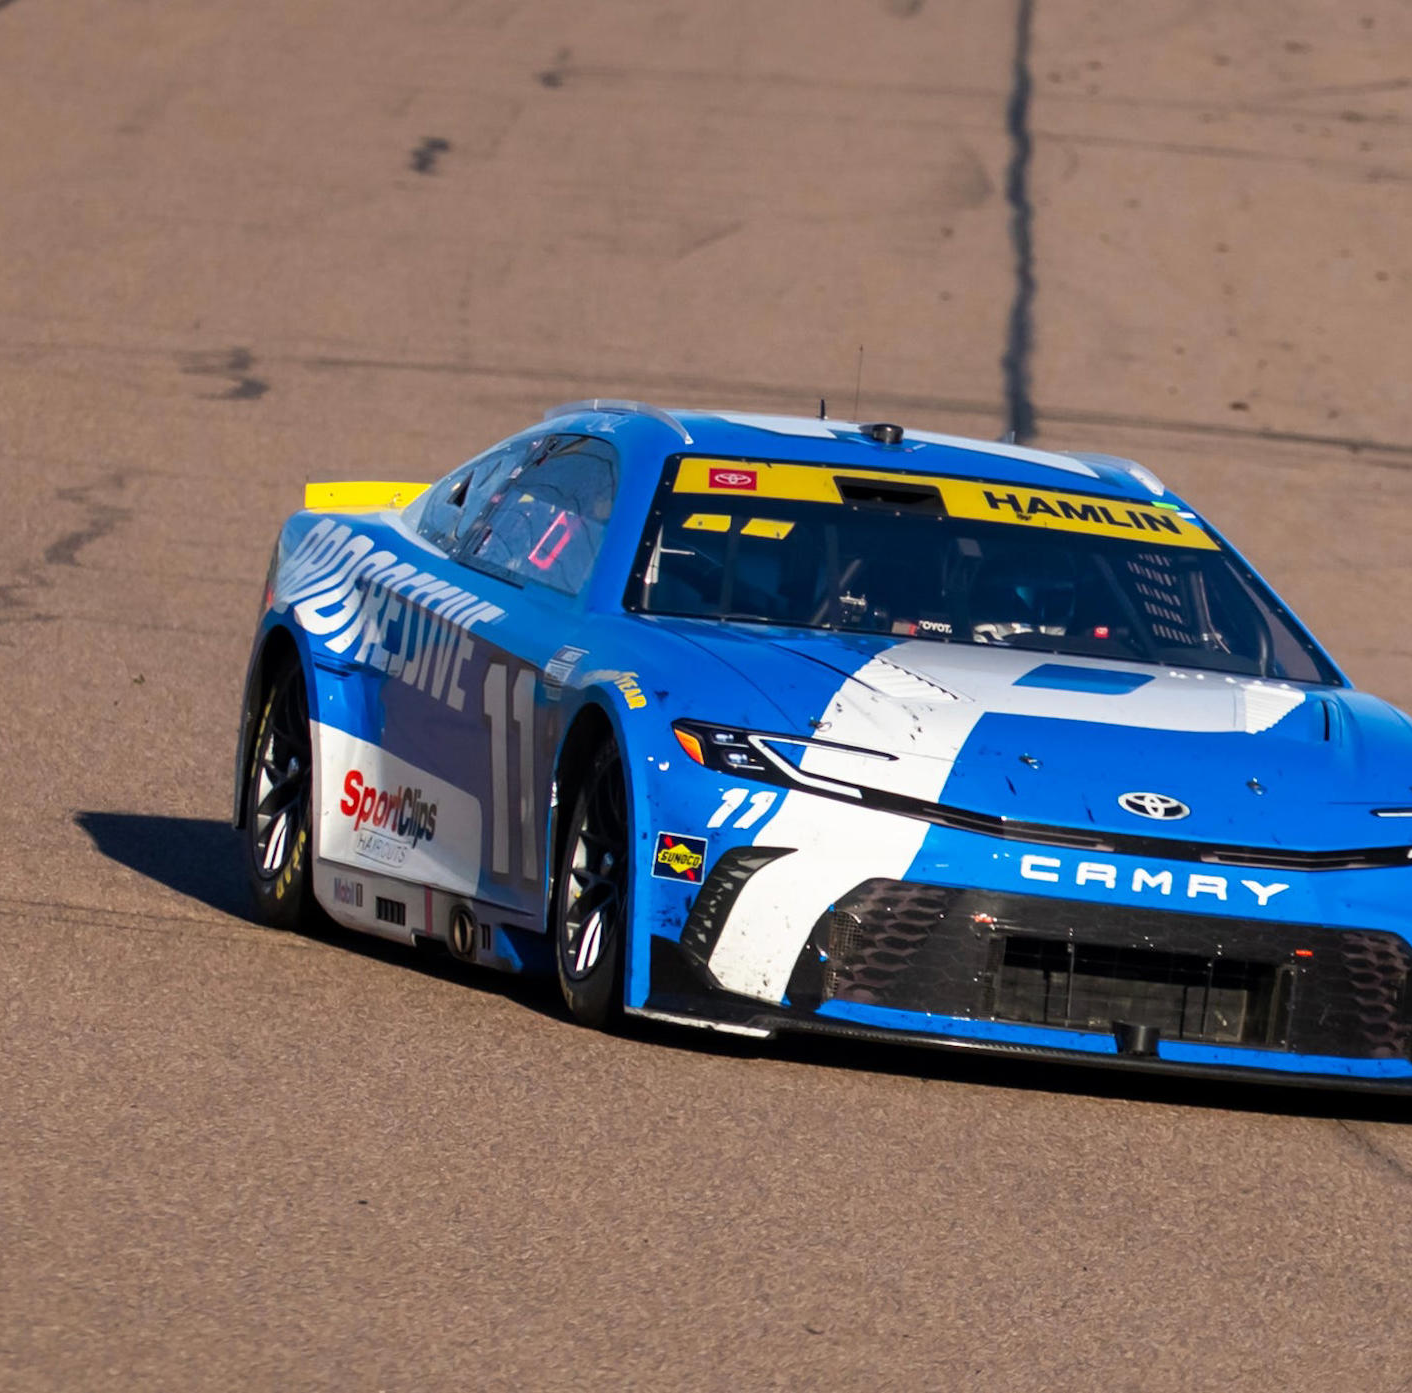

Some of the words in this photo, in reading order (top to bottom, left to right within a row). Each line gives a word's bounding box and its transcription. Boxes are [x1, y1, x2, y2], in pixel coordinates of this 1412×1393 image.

[983, 490, 1183, 535] HAMLIN
[483, 662, 539, 880] 11
[706, 787, 778, 829] 11
[659, 850, 702, 868] SUNOCO
[1020, 854, 1290, 907] CAMRY
